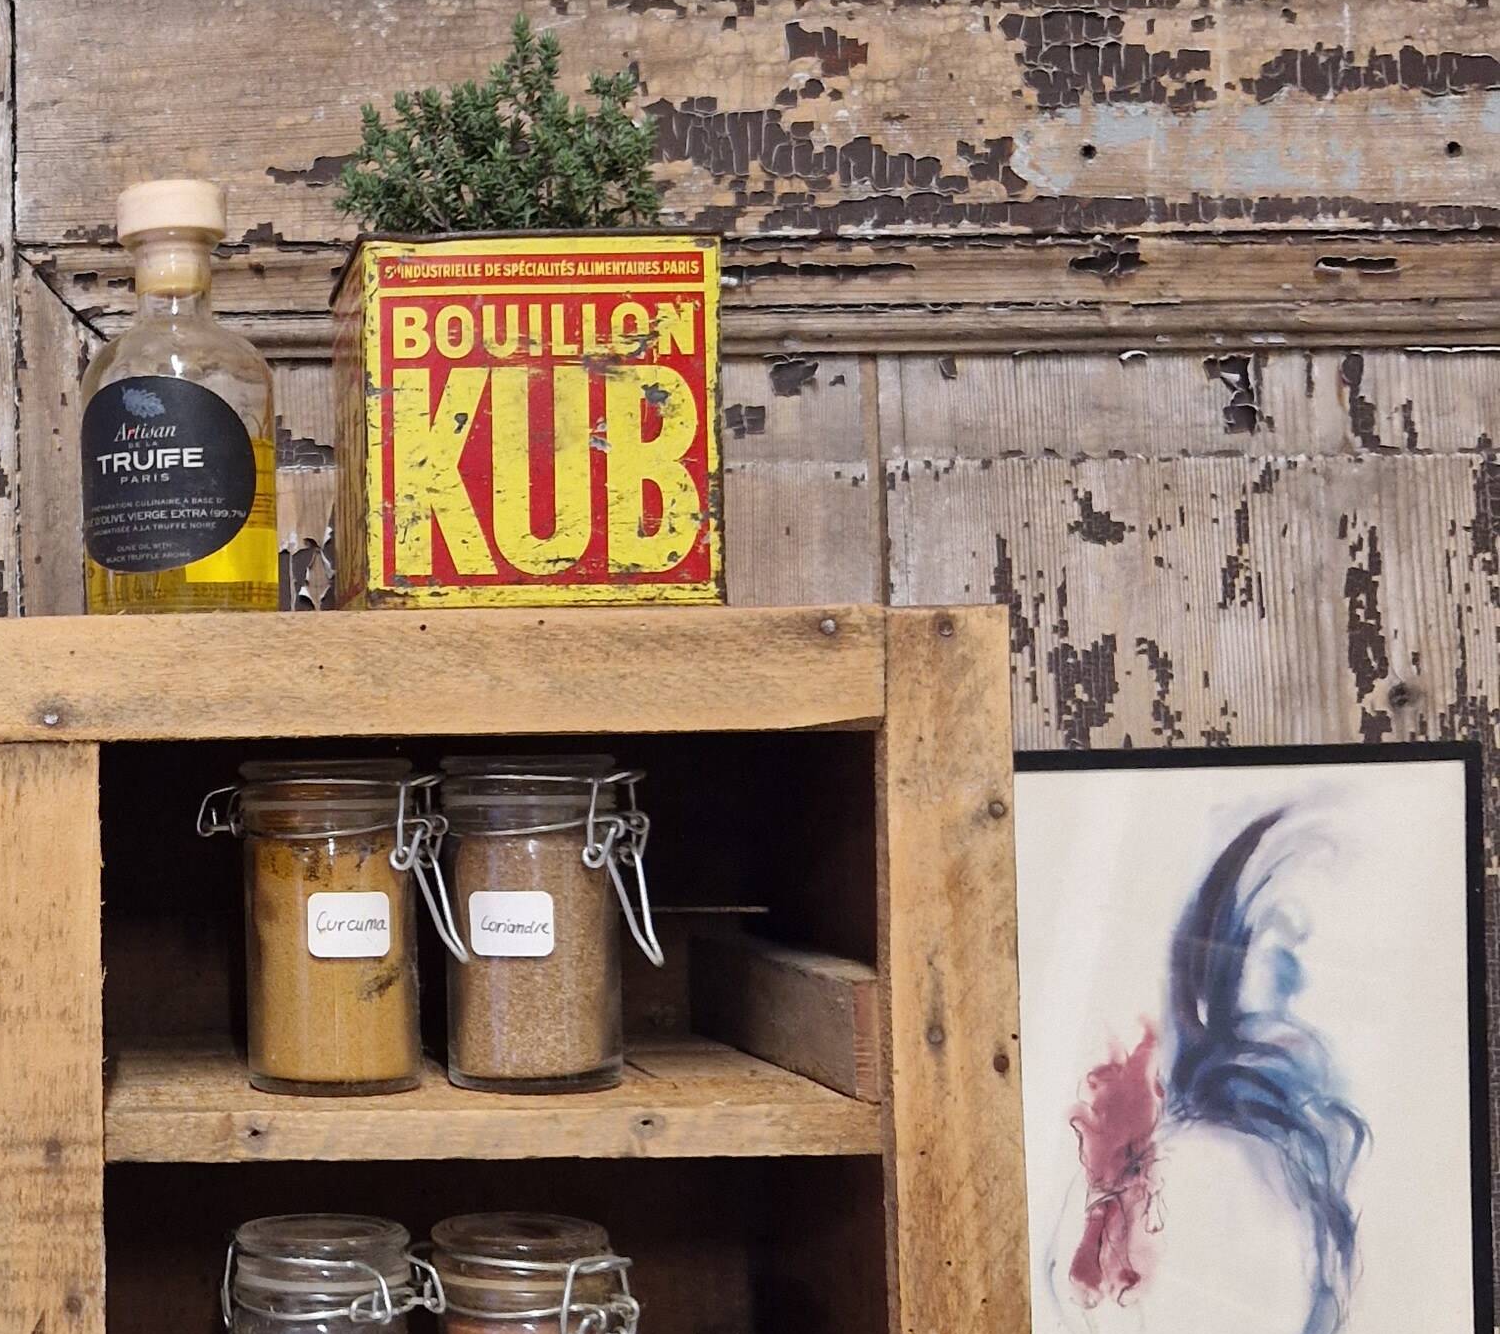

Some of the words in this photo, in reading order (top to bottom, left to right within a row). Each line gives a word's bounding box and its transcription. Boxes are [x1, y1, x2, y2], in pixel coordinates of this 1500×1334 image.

[484, 265, 501, 277] DE
[502, 260, 575, 277] SPÉCIALITÉS
[392, 302, 696, 359] BOUILLON
[113, 422, 177, 442] Artisan
[96, 447, 204, 475] TRUFFE
[392, 364, 701, 576] KUB
[120, 472, 170, 485] PARIS
[135, 498, 181, 508] CULINAIRE
[191, 497, 213, 505] BASE
[127, 510, 168, 522] VIERGE
[170, 509, 208, 519] EXTRA
[316, 911, 387, 932] Curcuma
[481, 915, 550, 935] Coriandre
